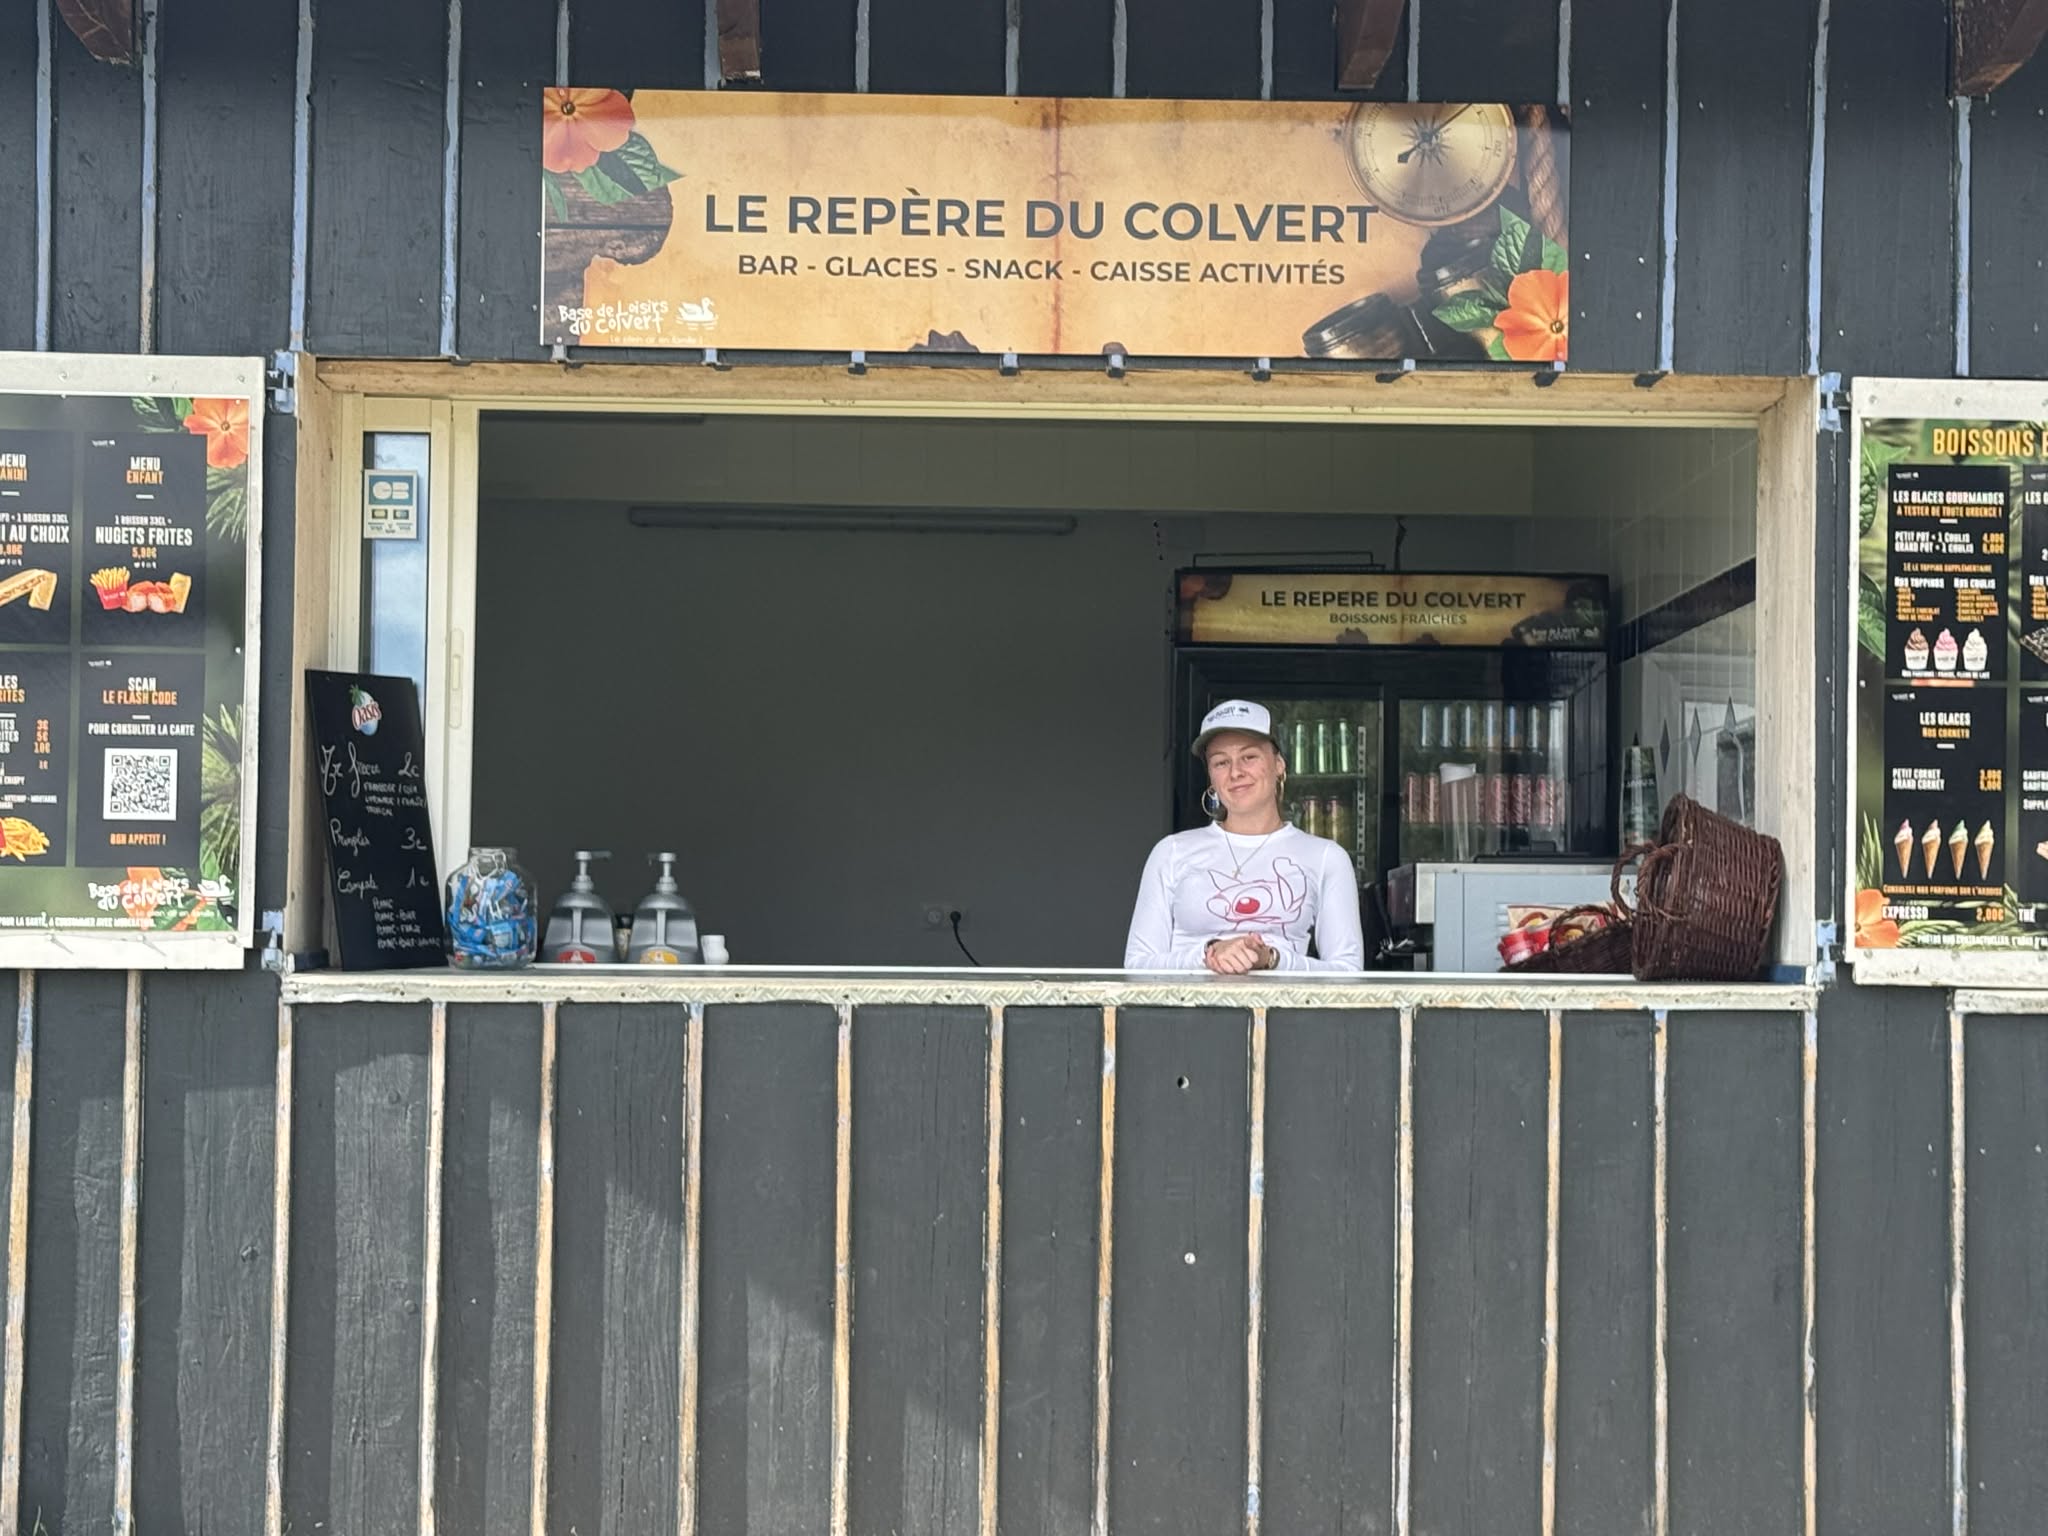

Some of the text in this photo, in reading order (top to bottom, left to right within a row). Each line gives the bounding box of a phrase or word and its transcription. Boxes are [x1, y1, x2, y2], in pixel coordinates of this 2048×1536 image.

[706, 187, 1379, 243] LE REPÈRE DU COLVERT
[738, 255, 798, 275] BAR
[825, 256, 937, 278] GLACES
[964, 258, 1063, 280] SNACK
[1090, 261, 1190, 282] CAISSE
[1200, 259, 1345, 284] ACTIVITÉS
[558, 300, 669, 322] Base de Loisirs
[570, 317, 591, 335] du
[1932, 428, 2035, 456] BOISSONS
[130, 456, 161, 470] MENU
[0, 467, 27, 481] ANINI
[126, 470, 164, 485] ENFANT
[1893, 490, 2005, 505] LES GLACES GOURMANDES
[2025, 491, 2041, 504] LES
[9, 524, 27, 542] AU
[30, 525, 70, 544] CHOIX
[95, 526, 193, 546] NUGETS FRITES
[1261, 592, 1526, 609] LE REPERE DU COLVERT
[1330, 613, 1467, 625] BOISSONS FRAICHES
[128, 677, 156, 691] SCAN
[0, 688, 25, 703] RITES
[103, 690, 177, 705] LE FLASH CODE
[1919, 712, 1971, 726] LES GLACES
[88, 723, 195, 737] POUR CONSULTER LA CARTE
[128, 833, 161, 845] APPETIT
[88, 883, 120, 899] Base
[123, 881, 140, 894] de
[97, 893, 119, 911] du
[1882, 906, 1929, 920] EXPRESSO
